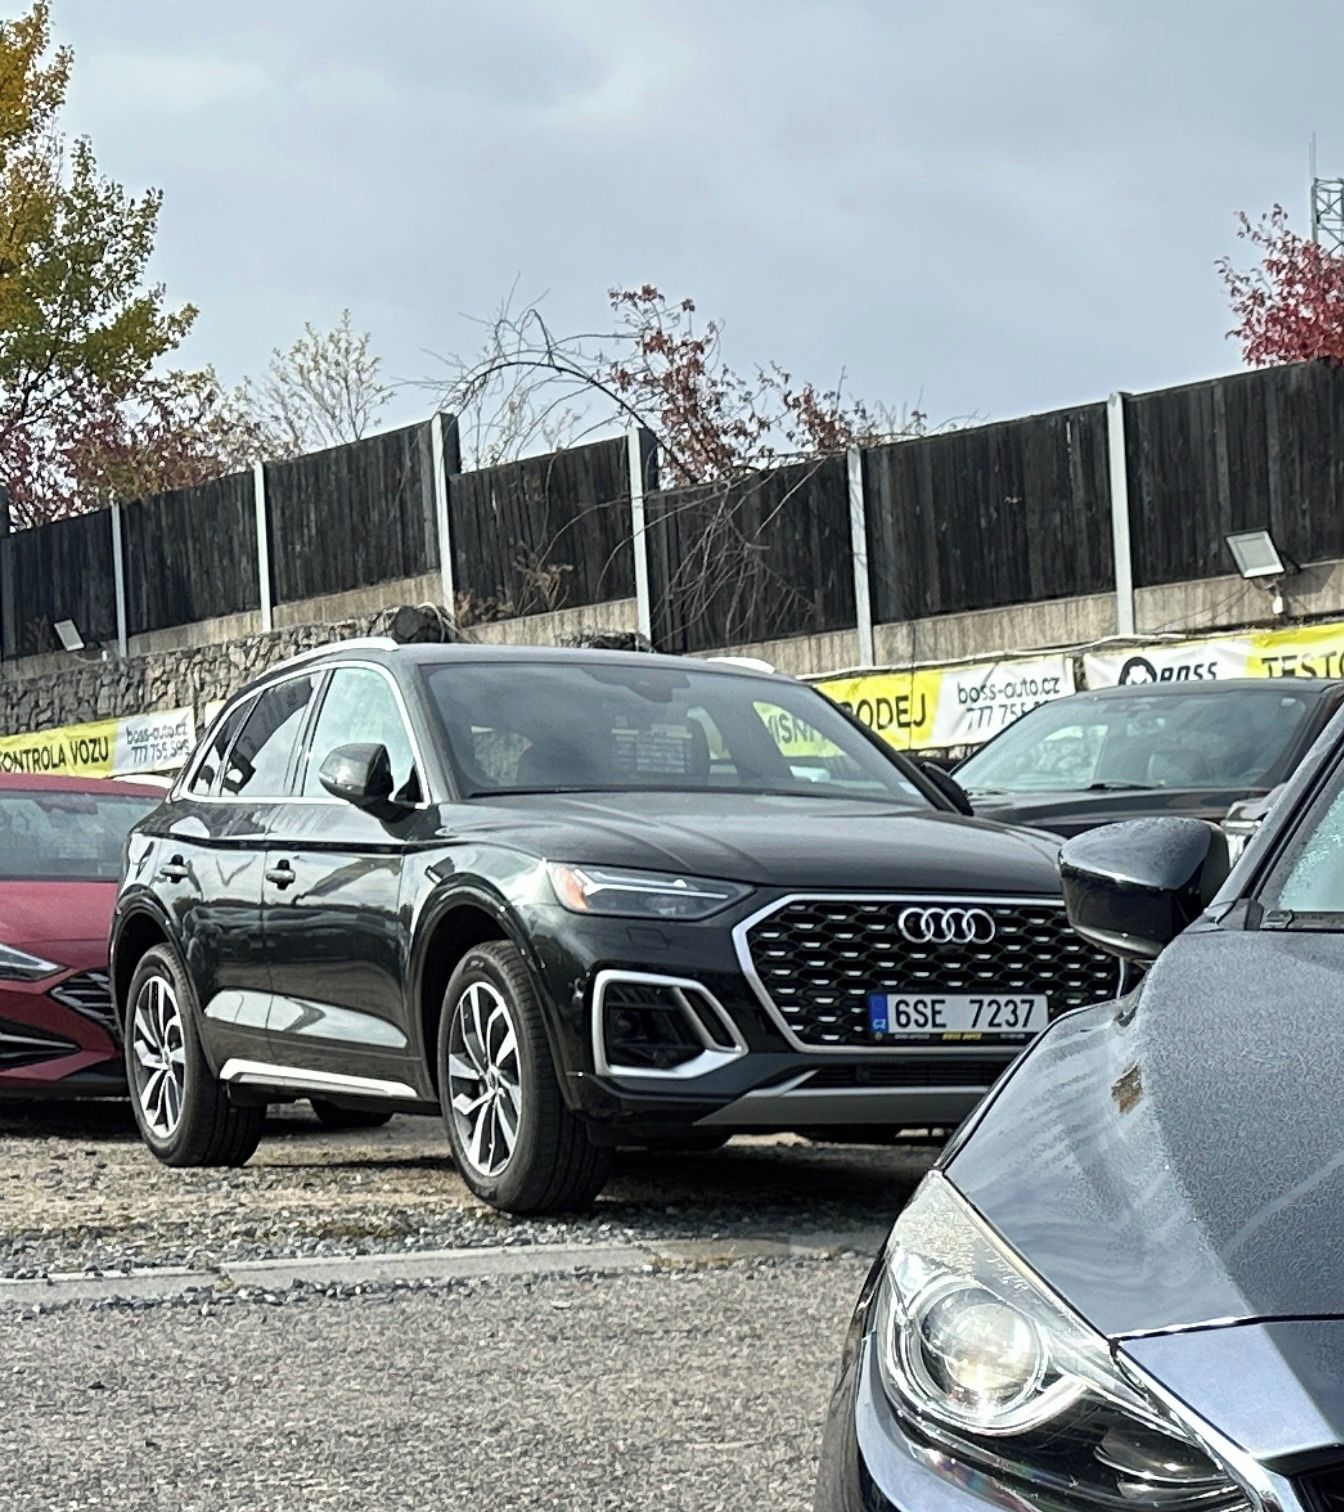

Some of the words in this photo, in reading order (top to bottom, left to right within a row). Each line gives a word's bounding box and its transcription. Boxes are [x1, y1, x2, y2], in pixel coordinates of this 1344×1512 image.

[957, 677, 1060, 704] boss-auto.cz
[966, 705, 993, 730] 777
[0, 744, 66, 773] ONTROLA
[70, 736, 109, 765] VOZU
[895, 999, 946, 1028] 6SE
[969, 999, 1034, 1029] 7237
